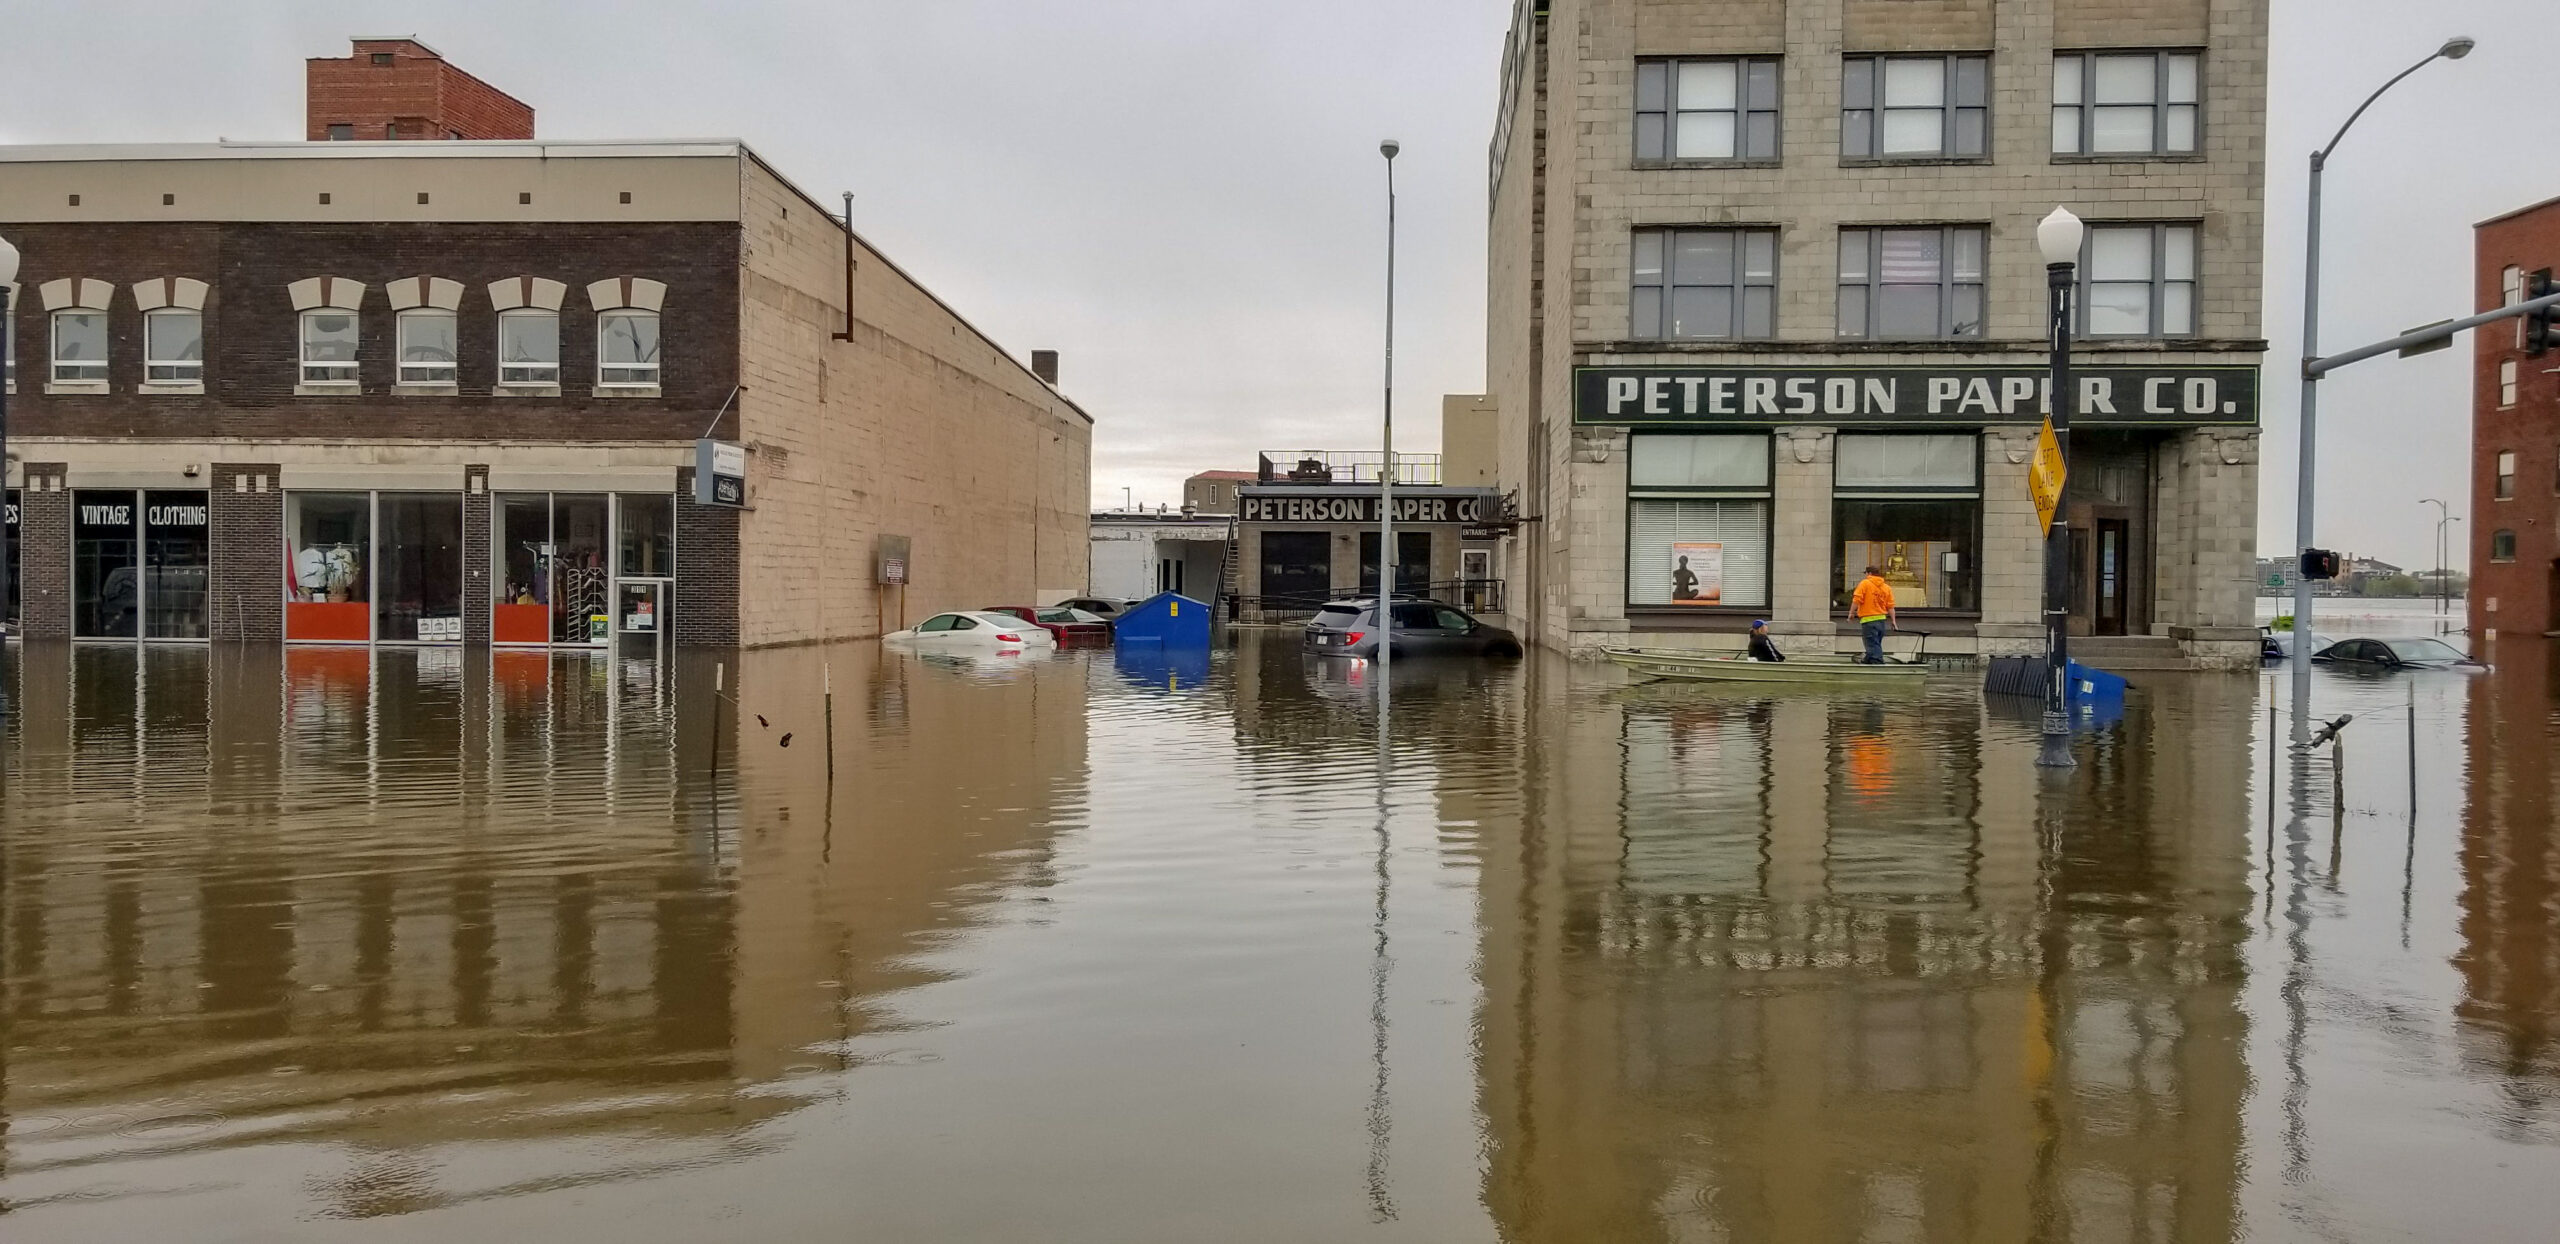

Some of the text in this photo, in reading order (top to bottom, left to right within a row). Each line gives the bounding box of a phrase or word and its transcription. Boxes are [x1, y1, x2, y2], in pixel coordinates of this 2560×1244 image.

[1607, 377, 1897, 415] PETERSON
[2144, 377, 2237, 414] CO.
[2039, 447, 2055, 466] LEFT
[2038, 470, 2054, 489] LANE
[1245, 498, 1364, 521] PETERSON
[2038, 494, 2054, 513] ENDS
[81, 505, 207, 526] VINTAGE CLOTHING
[1462, 528, 1488, 536] ENTRANCE
